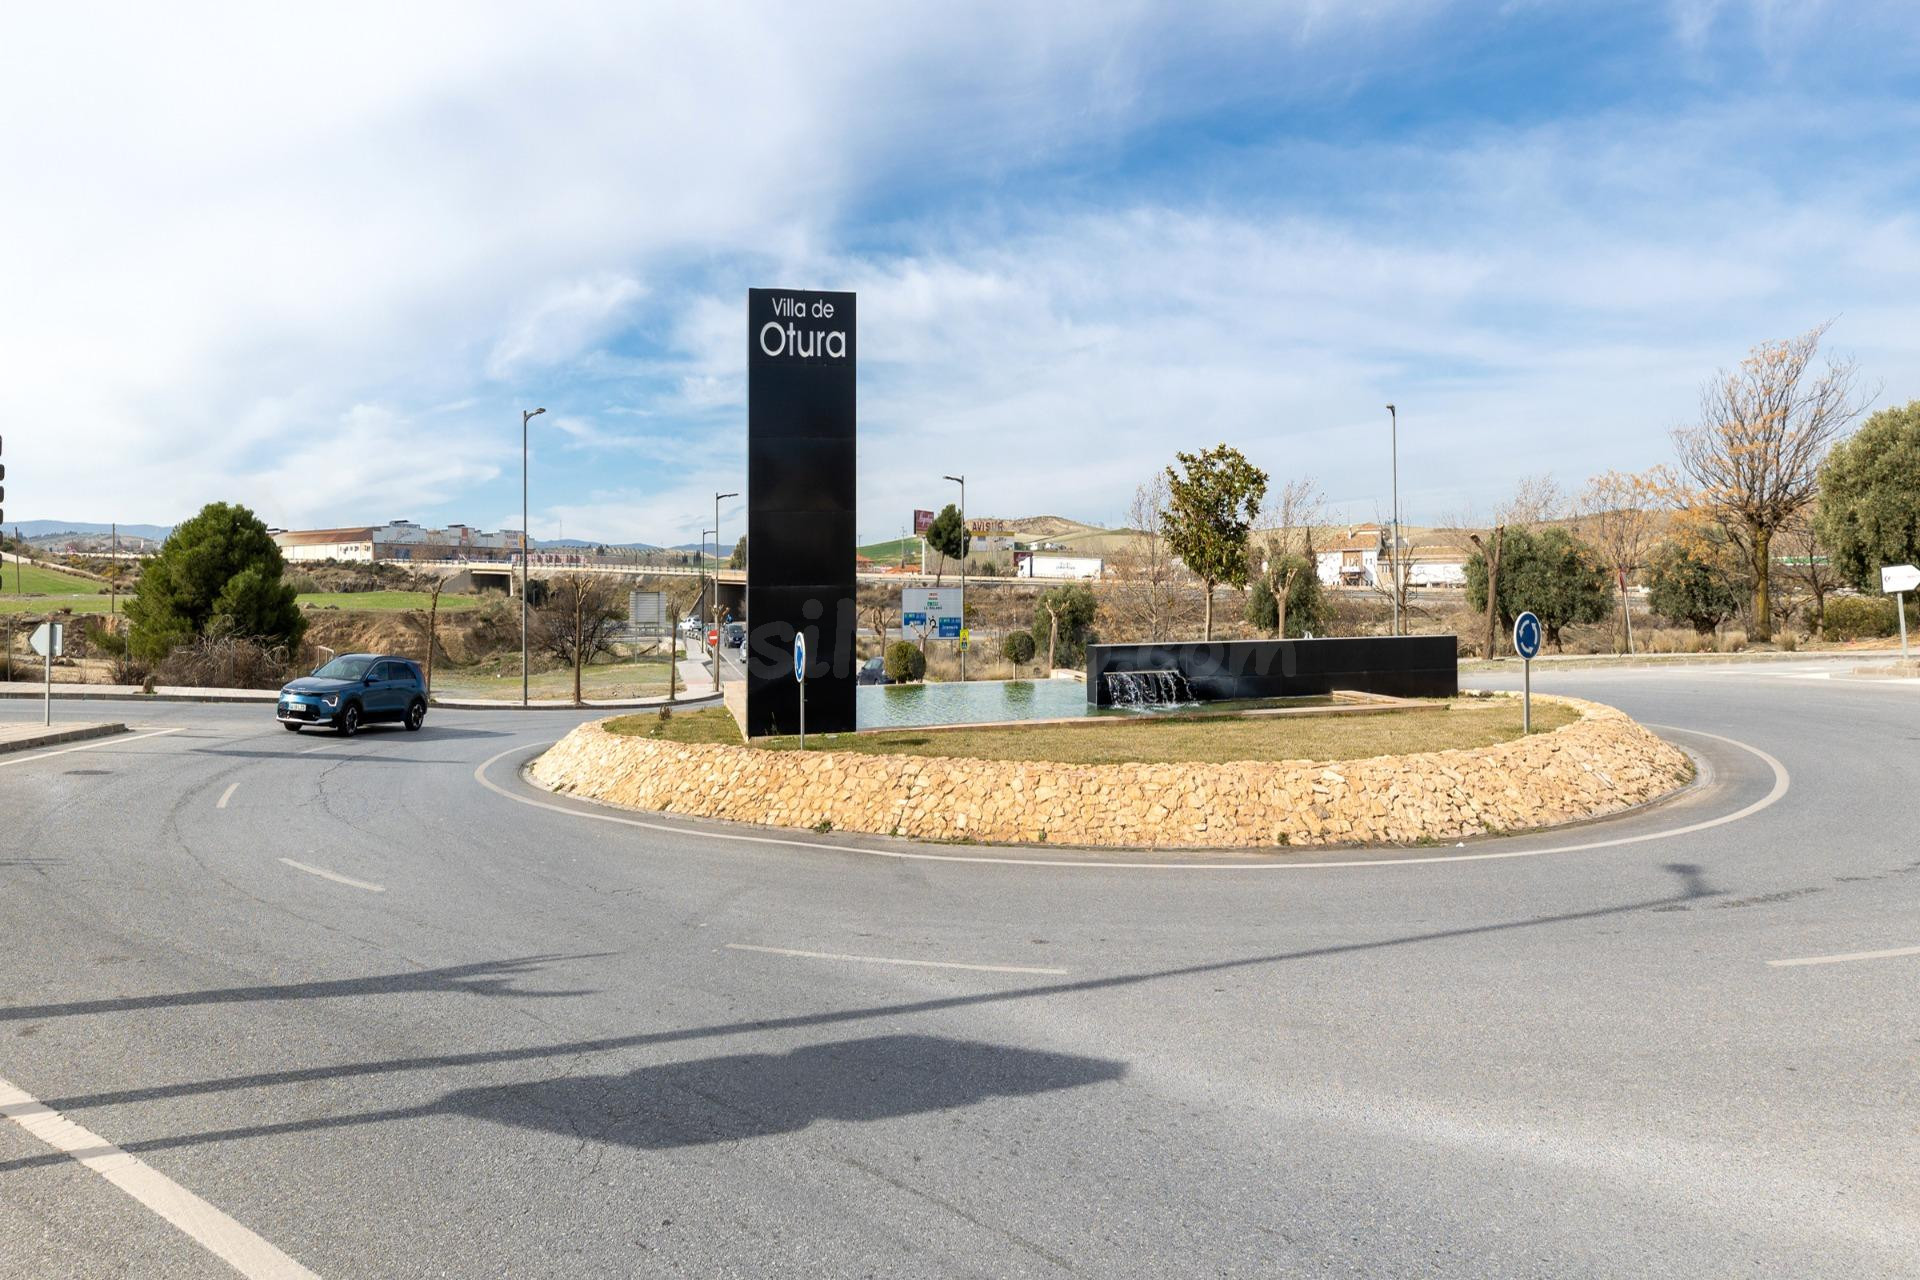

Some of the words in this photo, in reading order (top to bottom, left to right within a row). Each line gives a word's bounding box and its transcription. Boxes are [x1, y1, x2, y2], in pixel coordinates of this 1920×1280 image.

[771, 297, 806, 317] Villa
[811, 299, 835, 318] de
[760, 321, 846, 358] Otura
